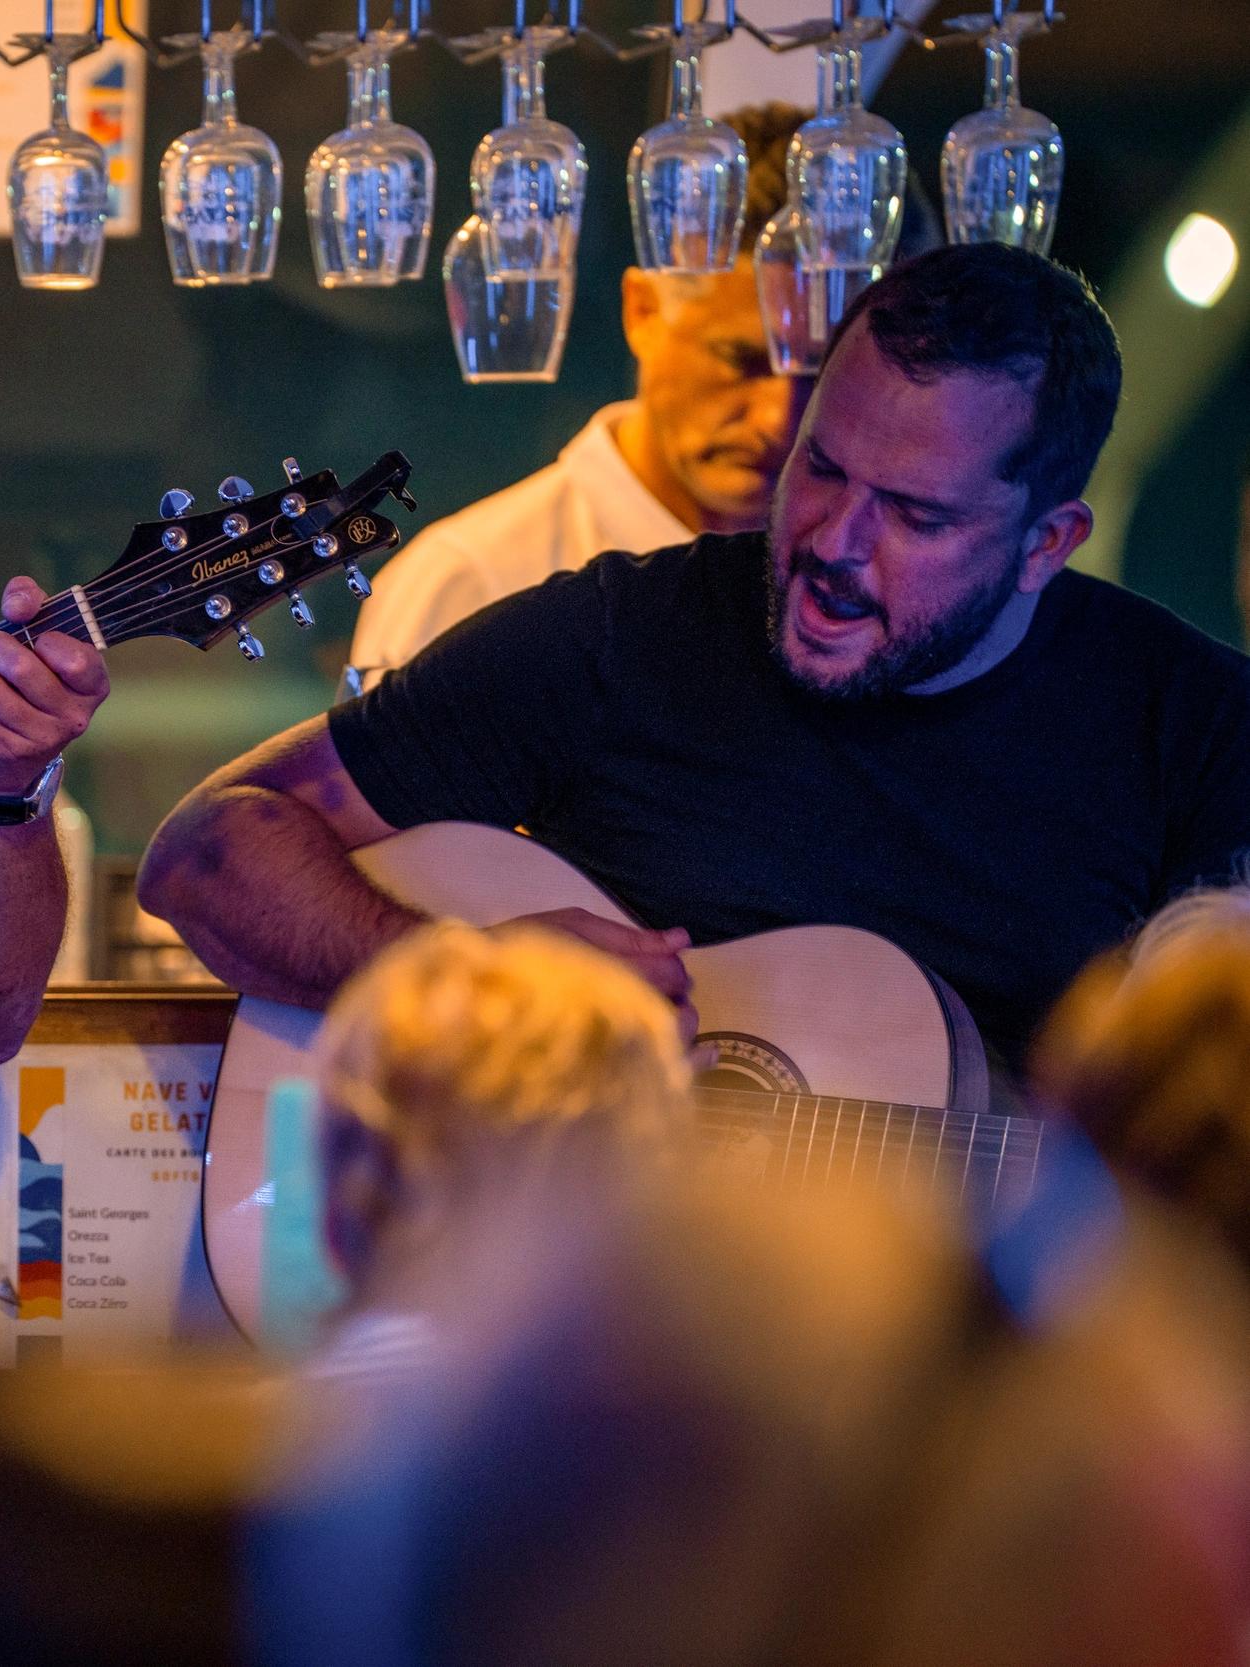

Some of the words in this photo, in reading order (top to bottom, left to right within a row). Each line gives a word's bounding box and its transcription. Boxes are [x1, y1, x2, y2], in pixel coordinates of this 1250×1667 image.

[191, 550, 250, 588] Ibanez
[124, 1081, 187, 1102] NAVE
[130, 1112, 207, 1132] GELAT
[106, 1148, 147, 1158] CARTE
[151, 1148, 175, 1158] DES
[150, 1170, 199, 1182] SOFTS
[68, 1207, 97, 1219] Saint
[100, 1207, 149, 1221] Georges
[68, 1230, 109, 1242] Orezza
[68, 1252, 85, 1264] Ice
[88, 1252, 110, 1264] Tea
[68, 1275, 96, 1287] Coca
[100, 1275, 126, 1287] Cola
[68, 1297, 96, 1309] Coca
